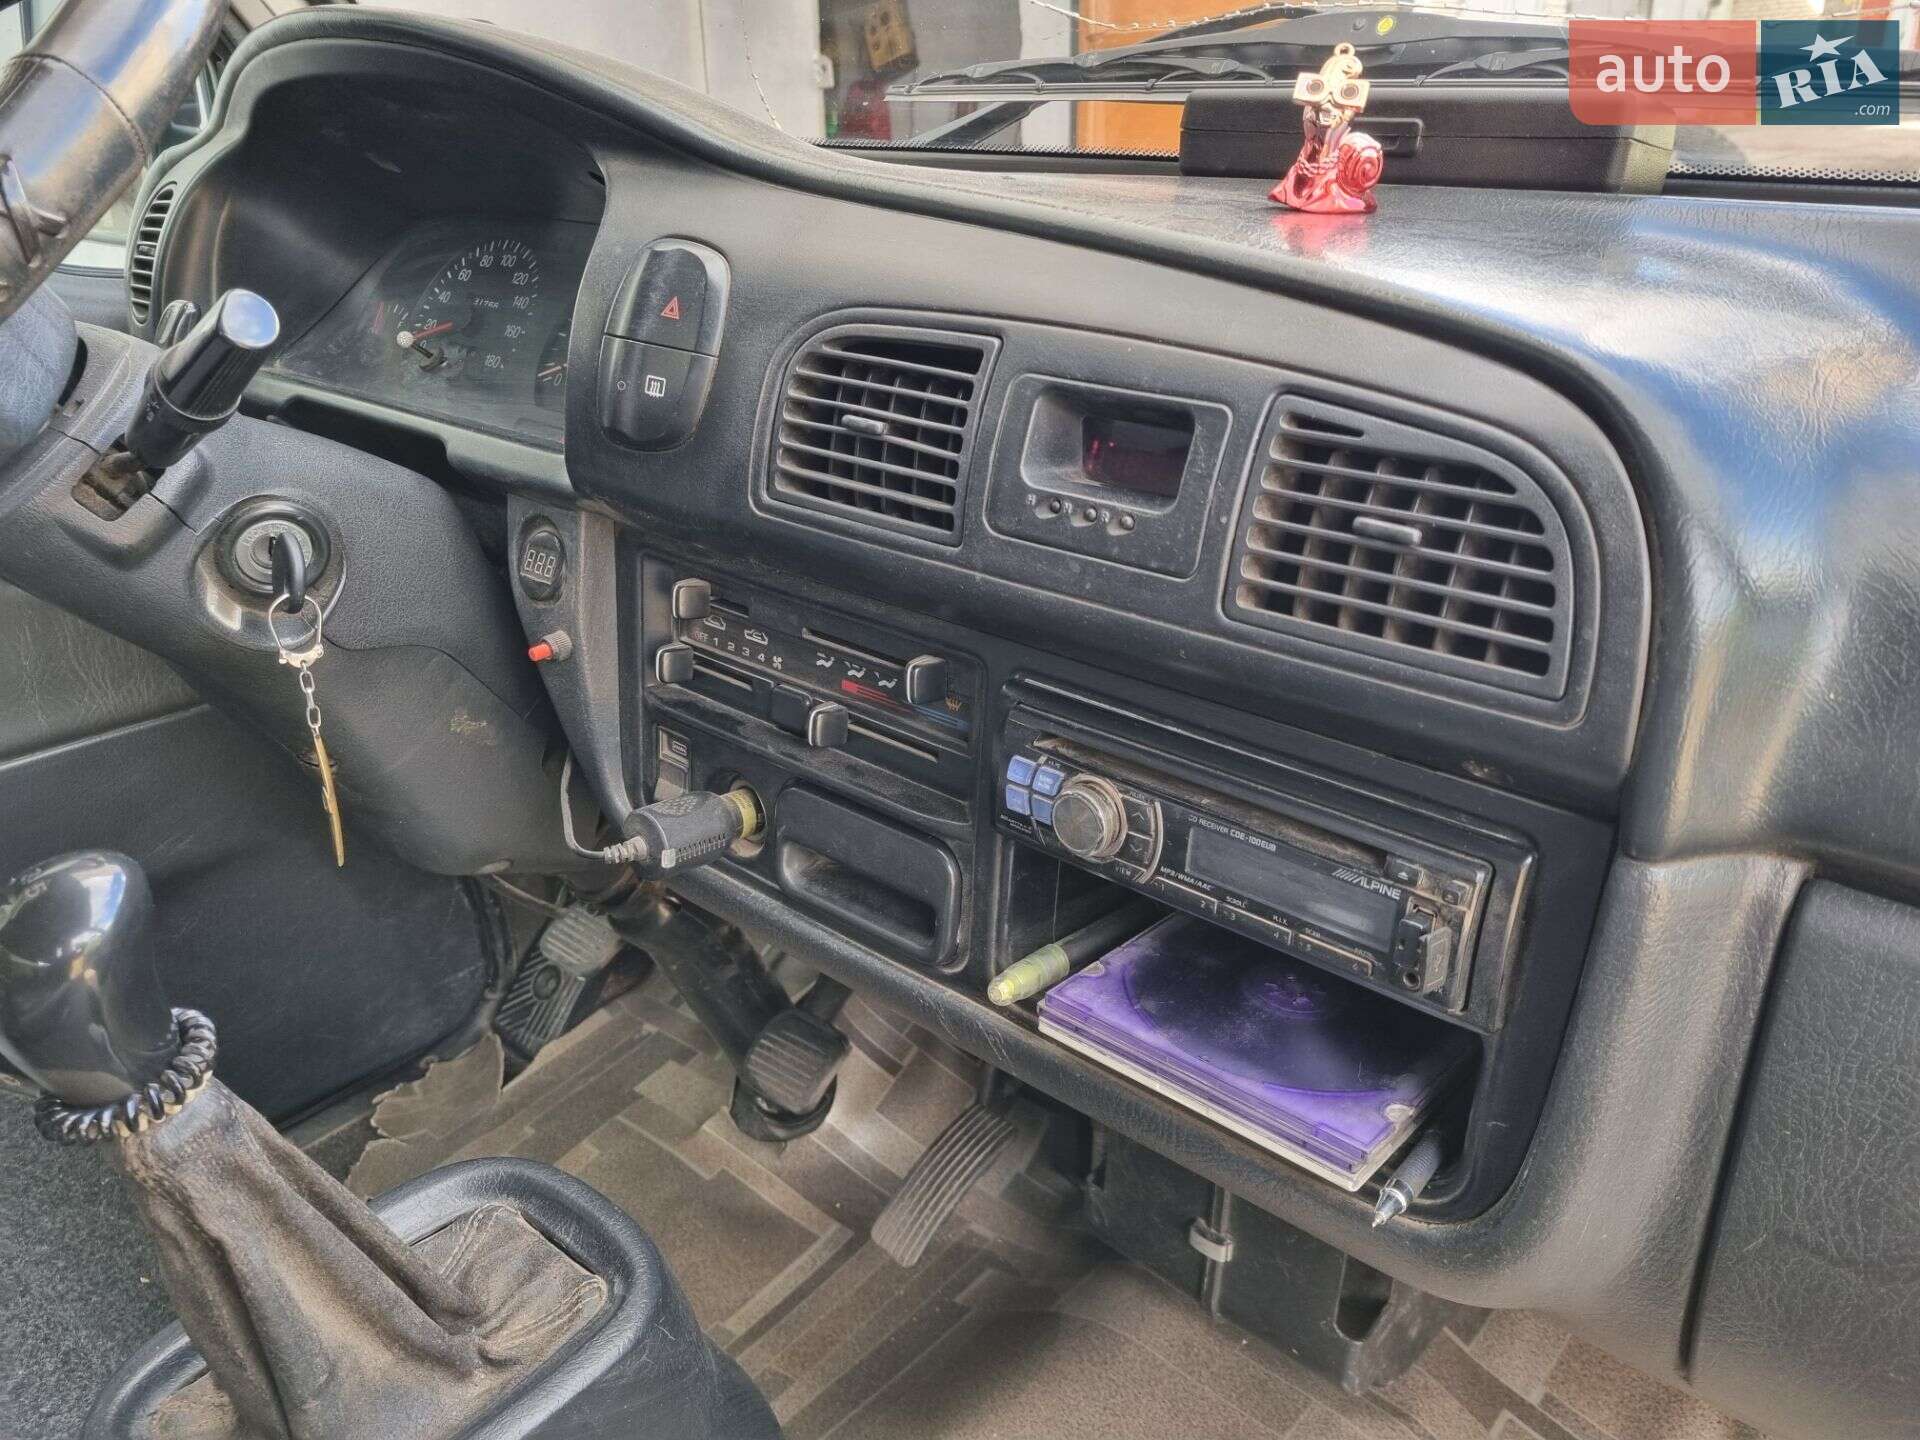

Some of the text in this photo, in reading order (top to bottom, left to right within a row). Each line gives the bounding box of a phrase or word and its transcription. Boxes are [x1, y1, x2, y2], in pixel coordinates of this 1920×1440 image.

[479, 254, 494, 268] 80
[500, 254, 517, 267] 100
[458, 268, 472, 281] 60
[512, 272, 529, 286] 120
[438, 290, 451, 304] 40
[512, 296, 530, 310] 140
[504, 325, 521, 338] 160
[484, 353, 501, 368] 180
[713, 637, 719, 647] 1
[727, 641, 735, 652] 2
[742, 646, 750, 657] 3
[757, 653, 766, 663] 4
[1354, 876, 1401, 900] ALPINE
